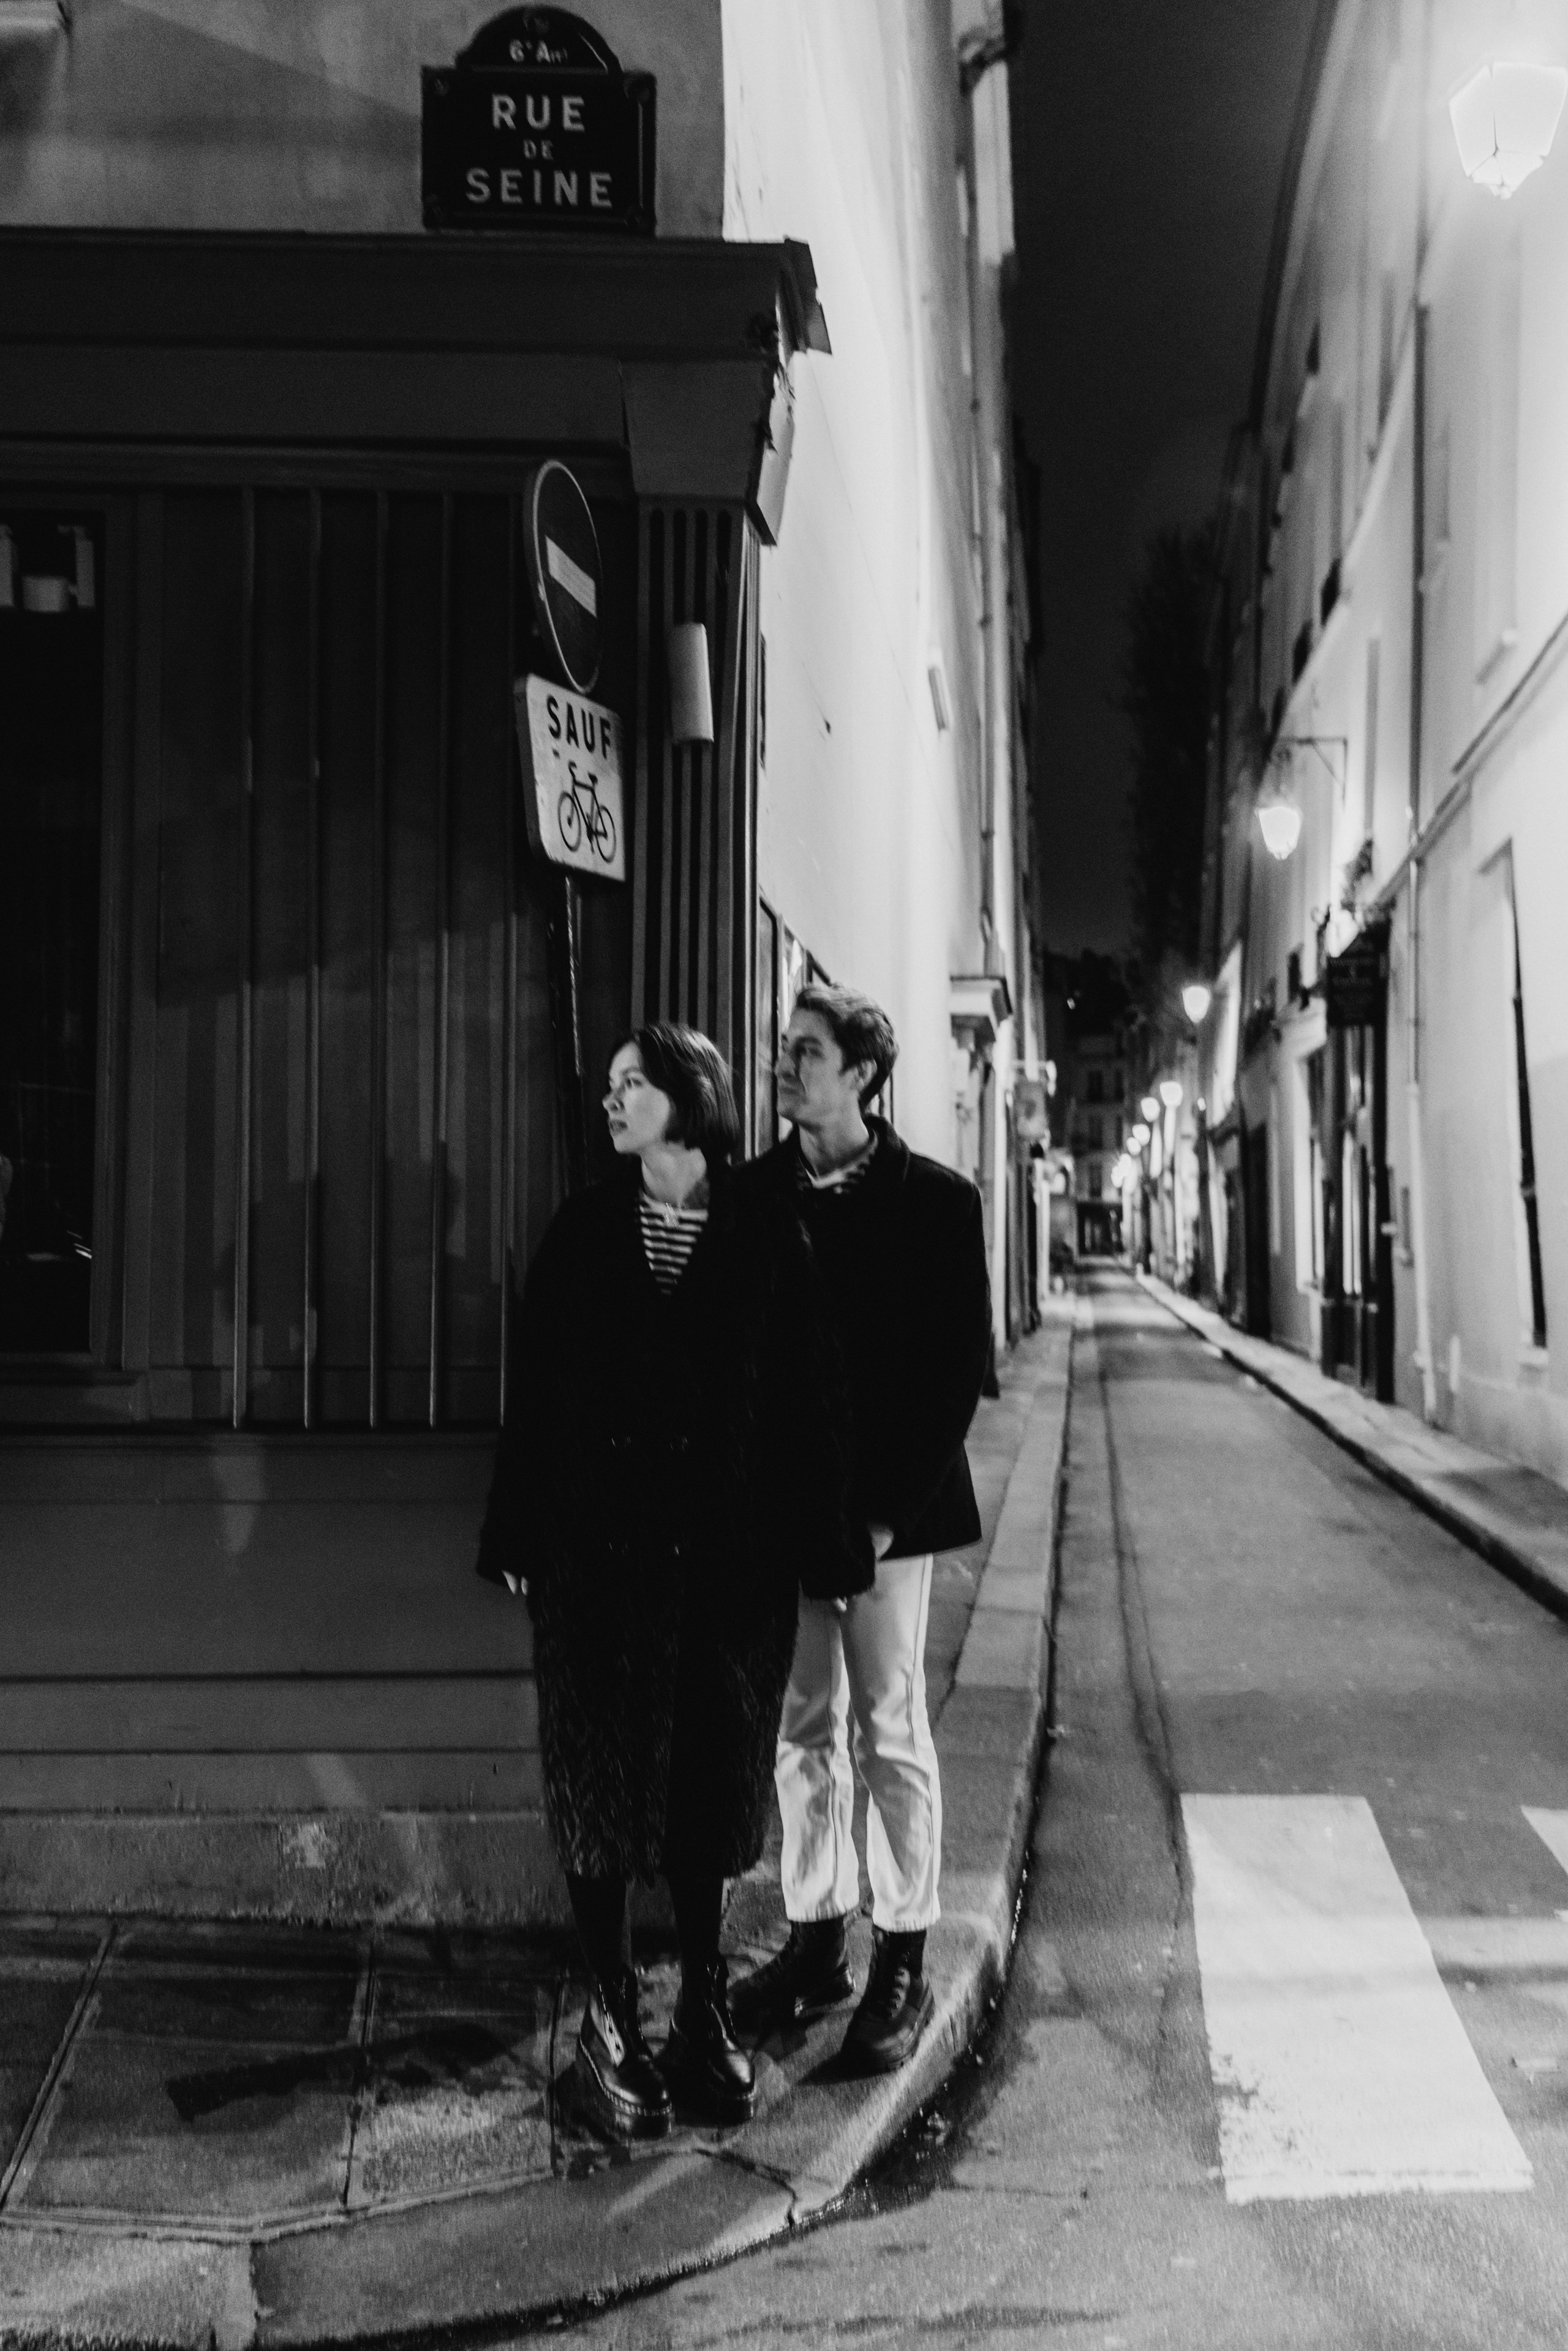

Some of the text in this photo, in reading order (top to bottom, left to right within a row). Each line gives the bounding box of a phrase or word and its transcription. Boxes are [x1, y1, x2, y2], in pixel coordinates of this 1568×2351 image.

[492, 94, 585, 132] RUE
[524, 139, 553, 160] DE
[466, 168, 612, 208] SEINE
[546, 693, 611, 760] SAUF
